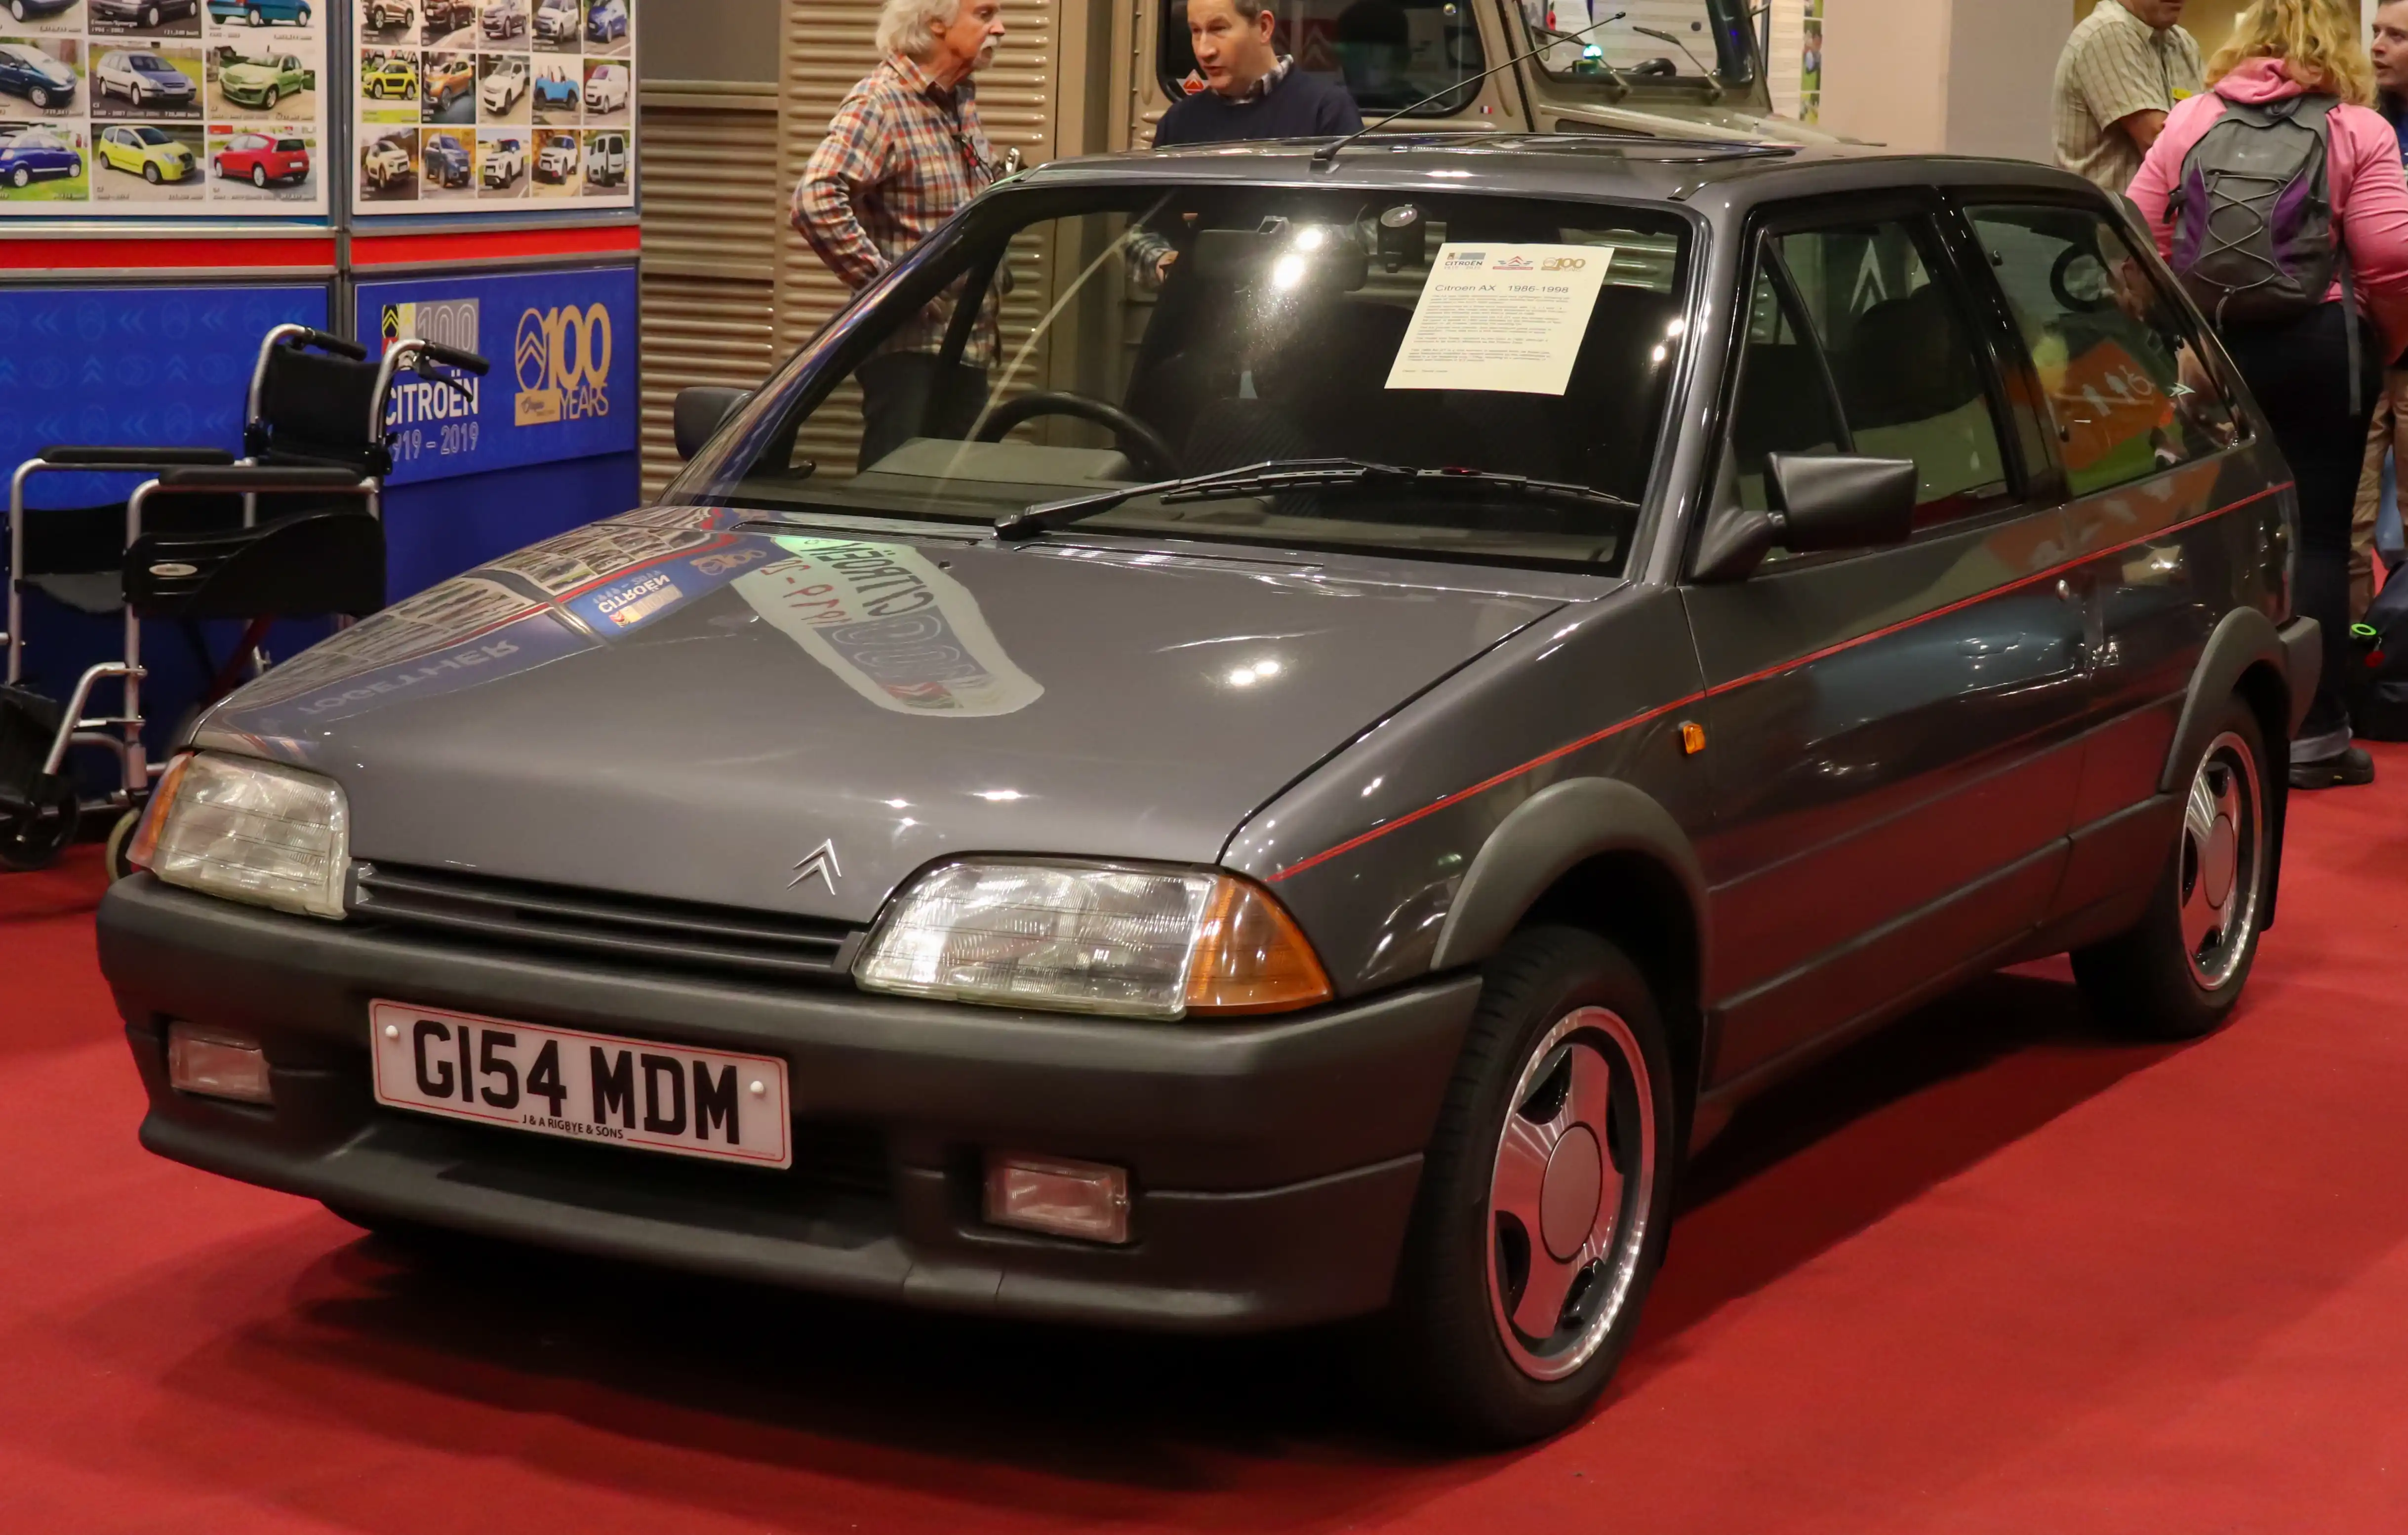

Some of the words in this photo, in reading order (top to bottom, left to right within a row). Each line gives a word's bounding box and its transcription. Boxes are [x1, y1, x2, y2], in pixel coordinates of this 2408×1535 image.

[1555, 258, 1586, 268] 100
[417, 304, 476, 354] 100
[543, 302, 612, 392] 100
[385, 369, 479, 426] CITROËN
[561, 384, 609, 420] YEARS
[388, 429, 422, 462] 919
[441, 421, 479, 455] 2019
[413, 1019, 567, 1117] G154
[590, 1046, 740, 1145] MDM
[522, 1114, 527, 1124] J
[529, 1115, 536, 1125] &
[539, 1117, 546, 1127] A
[548, 1118, 584, 1133] RIGBYE
[586, 1124, 594, 1134] &
[596, 1126, 624, 1139] SONS
